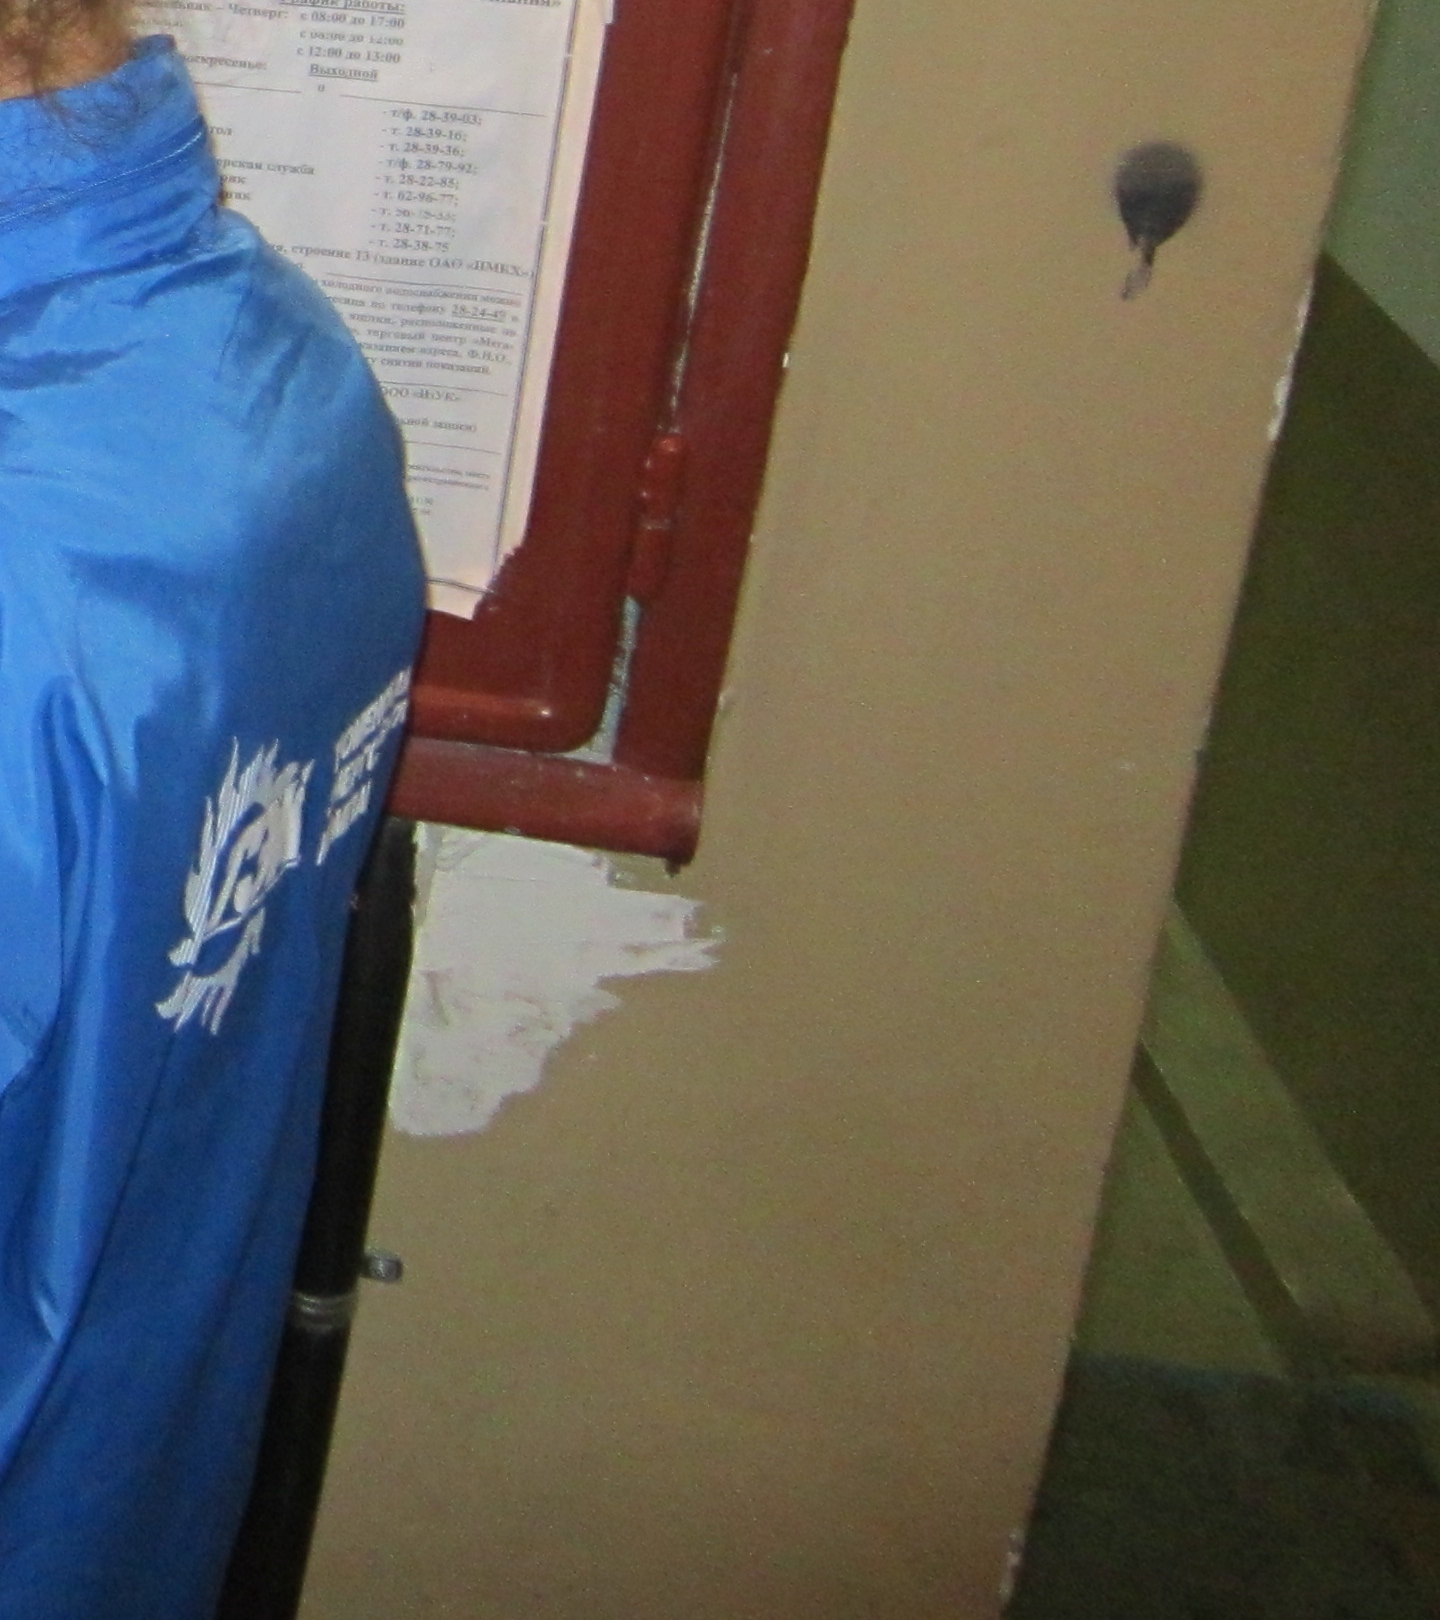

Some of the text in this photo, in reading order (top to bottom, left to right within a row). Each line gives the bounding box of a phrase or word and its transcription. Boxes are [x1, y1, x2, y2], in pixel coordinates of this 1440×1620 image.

[228, 2, 289, 21] Четверг:
[184, 54, 268, 71] оскресенье:
[309, 63, 378, 80] Выходной
